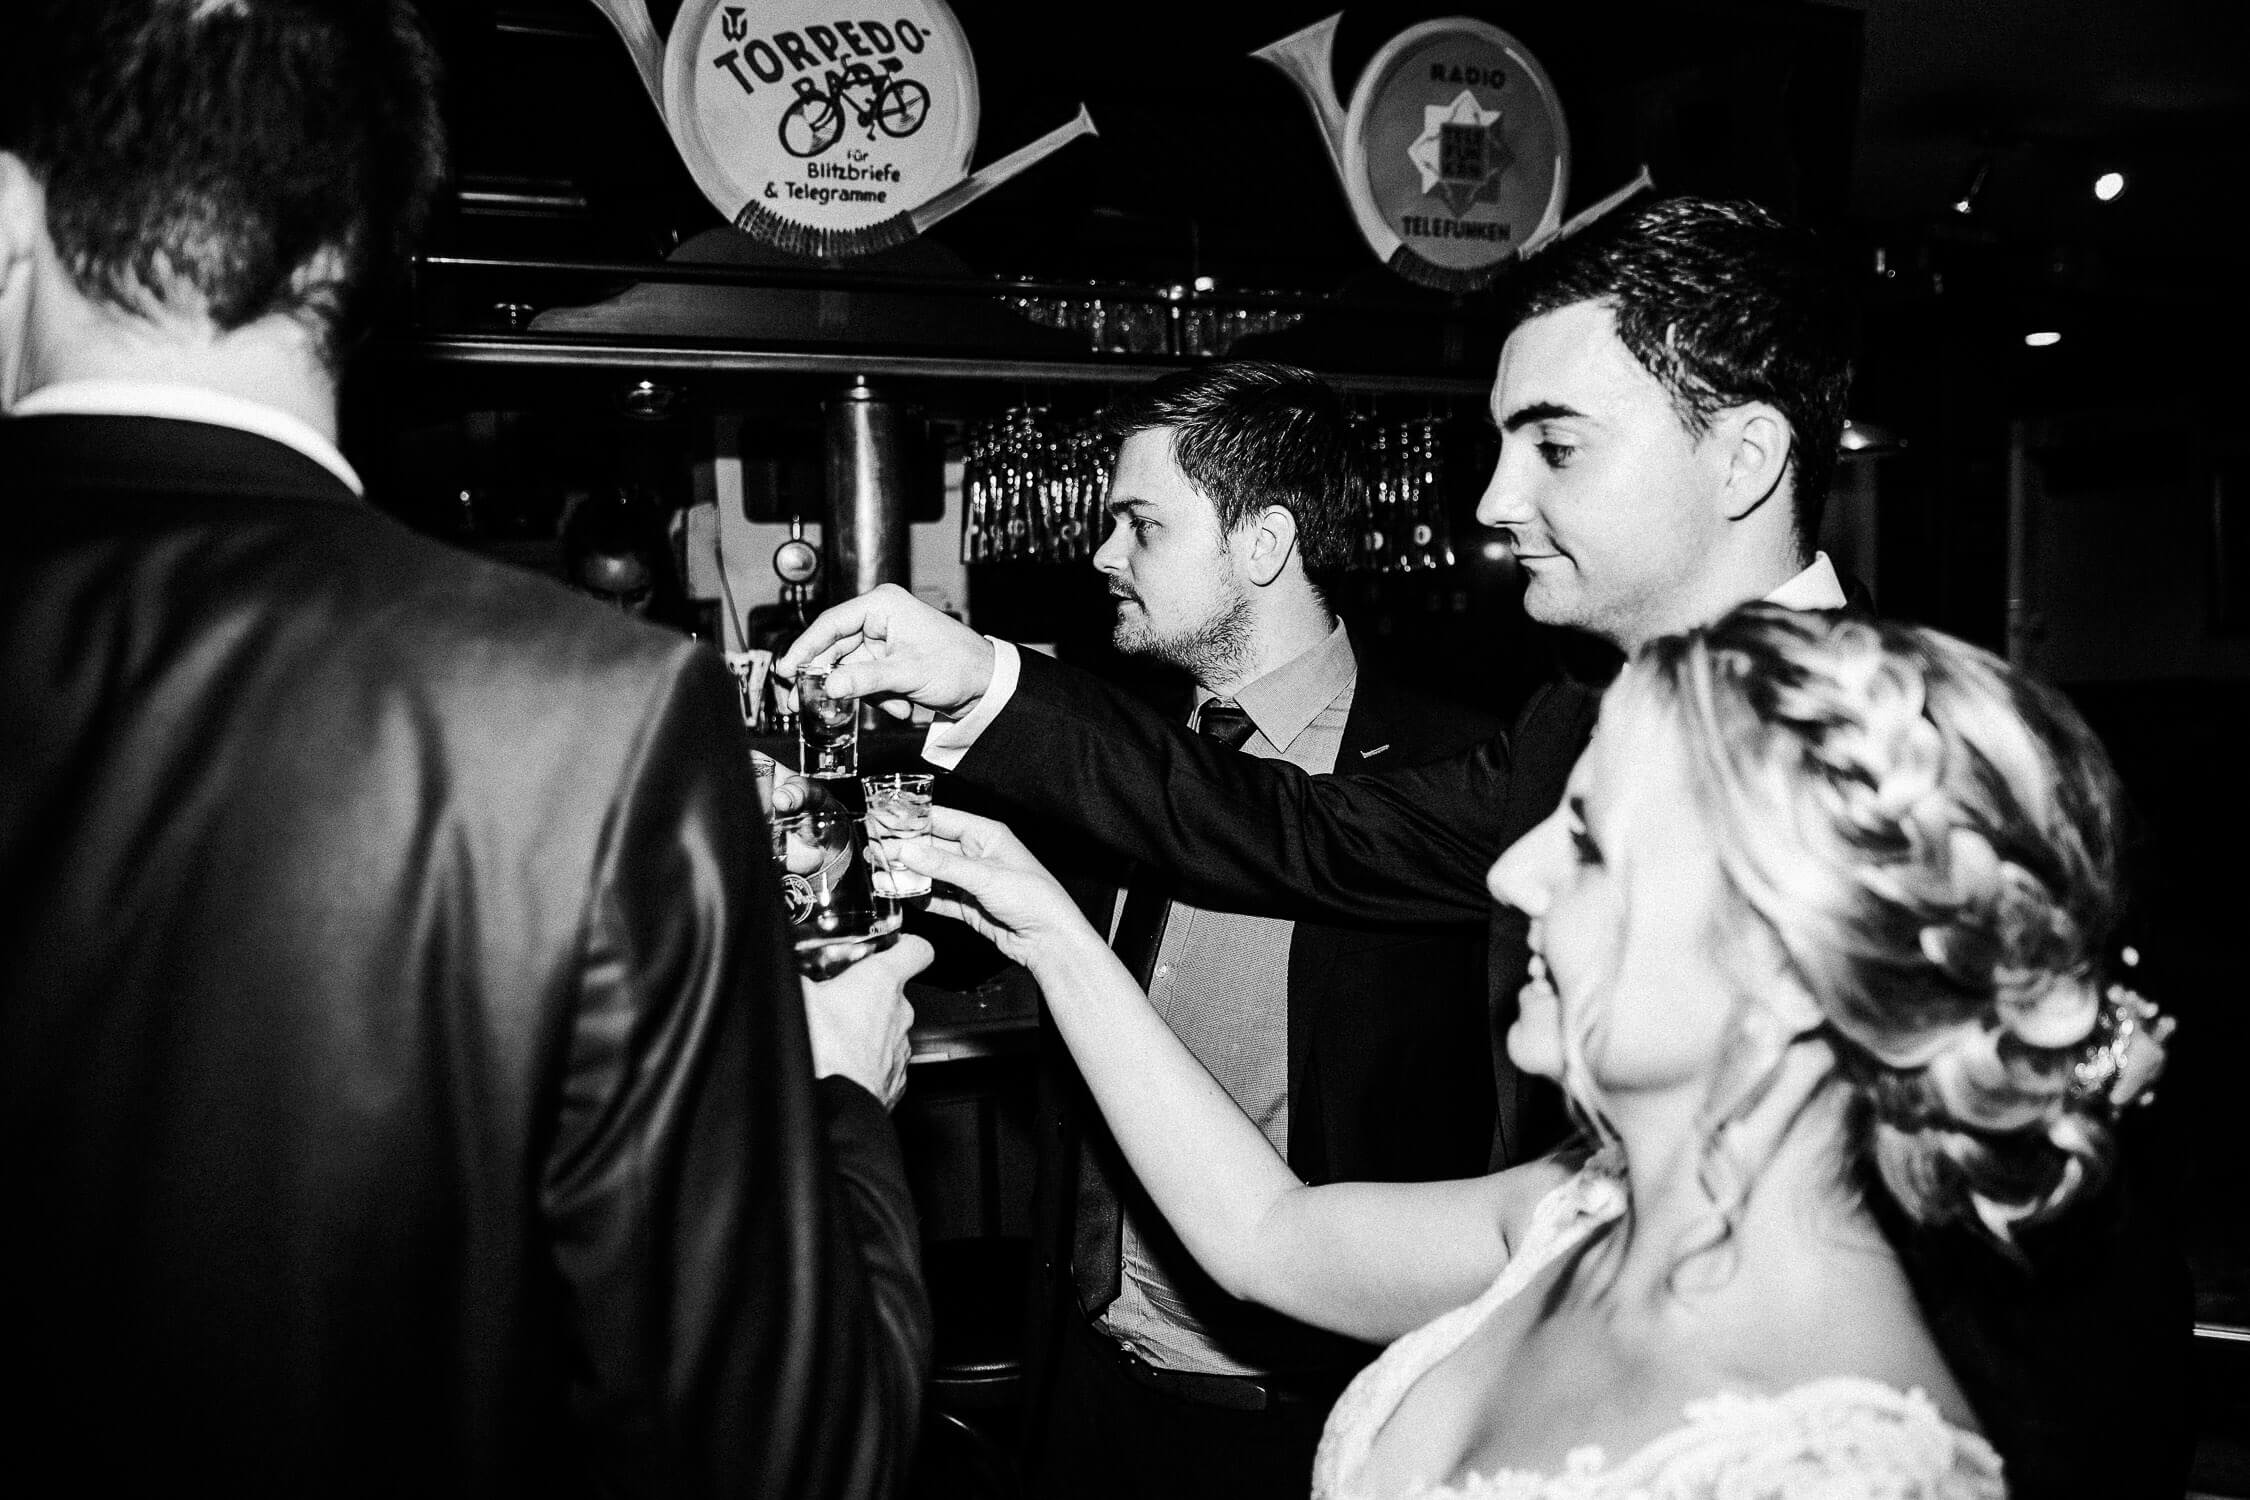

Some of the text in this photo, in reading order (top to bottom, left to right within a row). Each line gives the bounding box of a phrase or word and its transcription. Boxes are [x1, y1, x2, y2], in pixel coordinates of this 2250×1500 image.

[1430, 63, 1506, 90] RADIO
[807, 162, 901, 183] Blitzbriefe
[764, 181, 887, 205] & Telegramme
[1401, 215, 1511, 242] TELEFUNKEN
